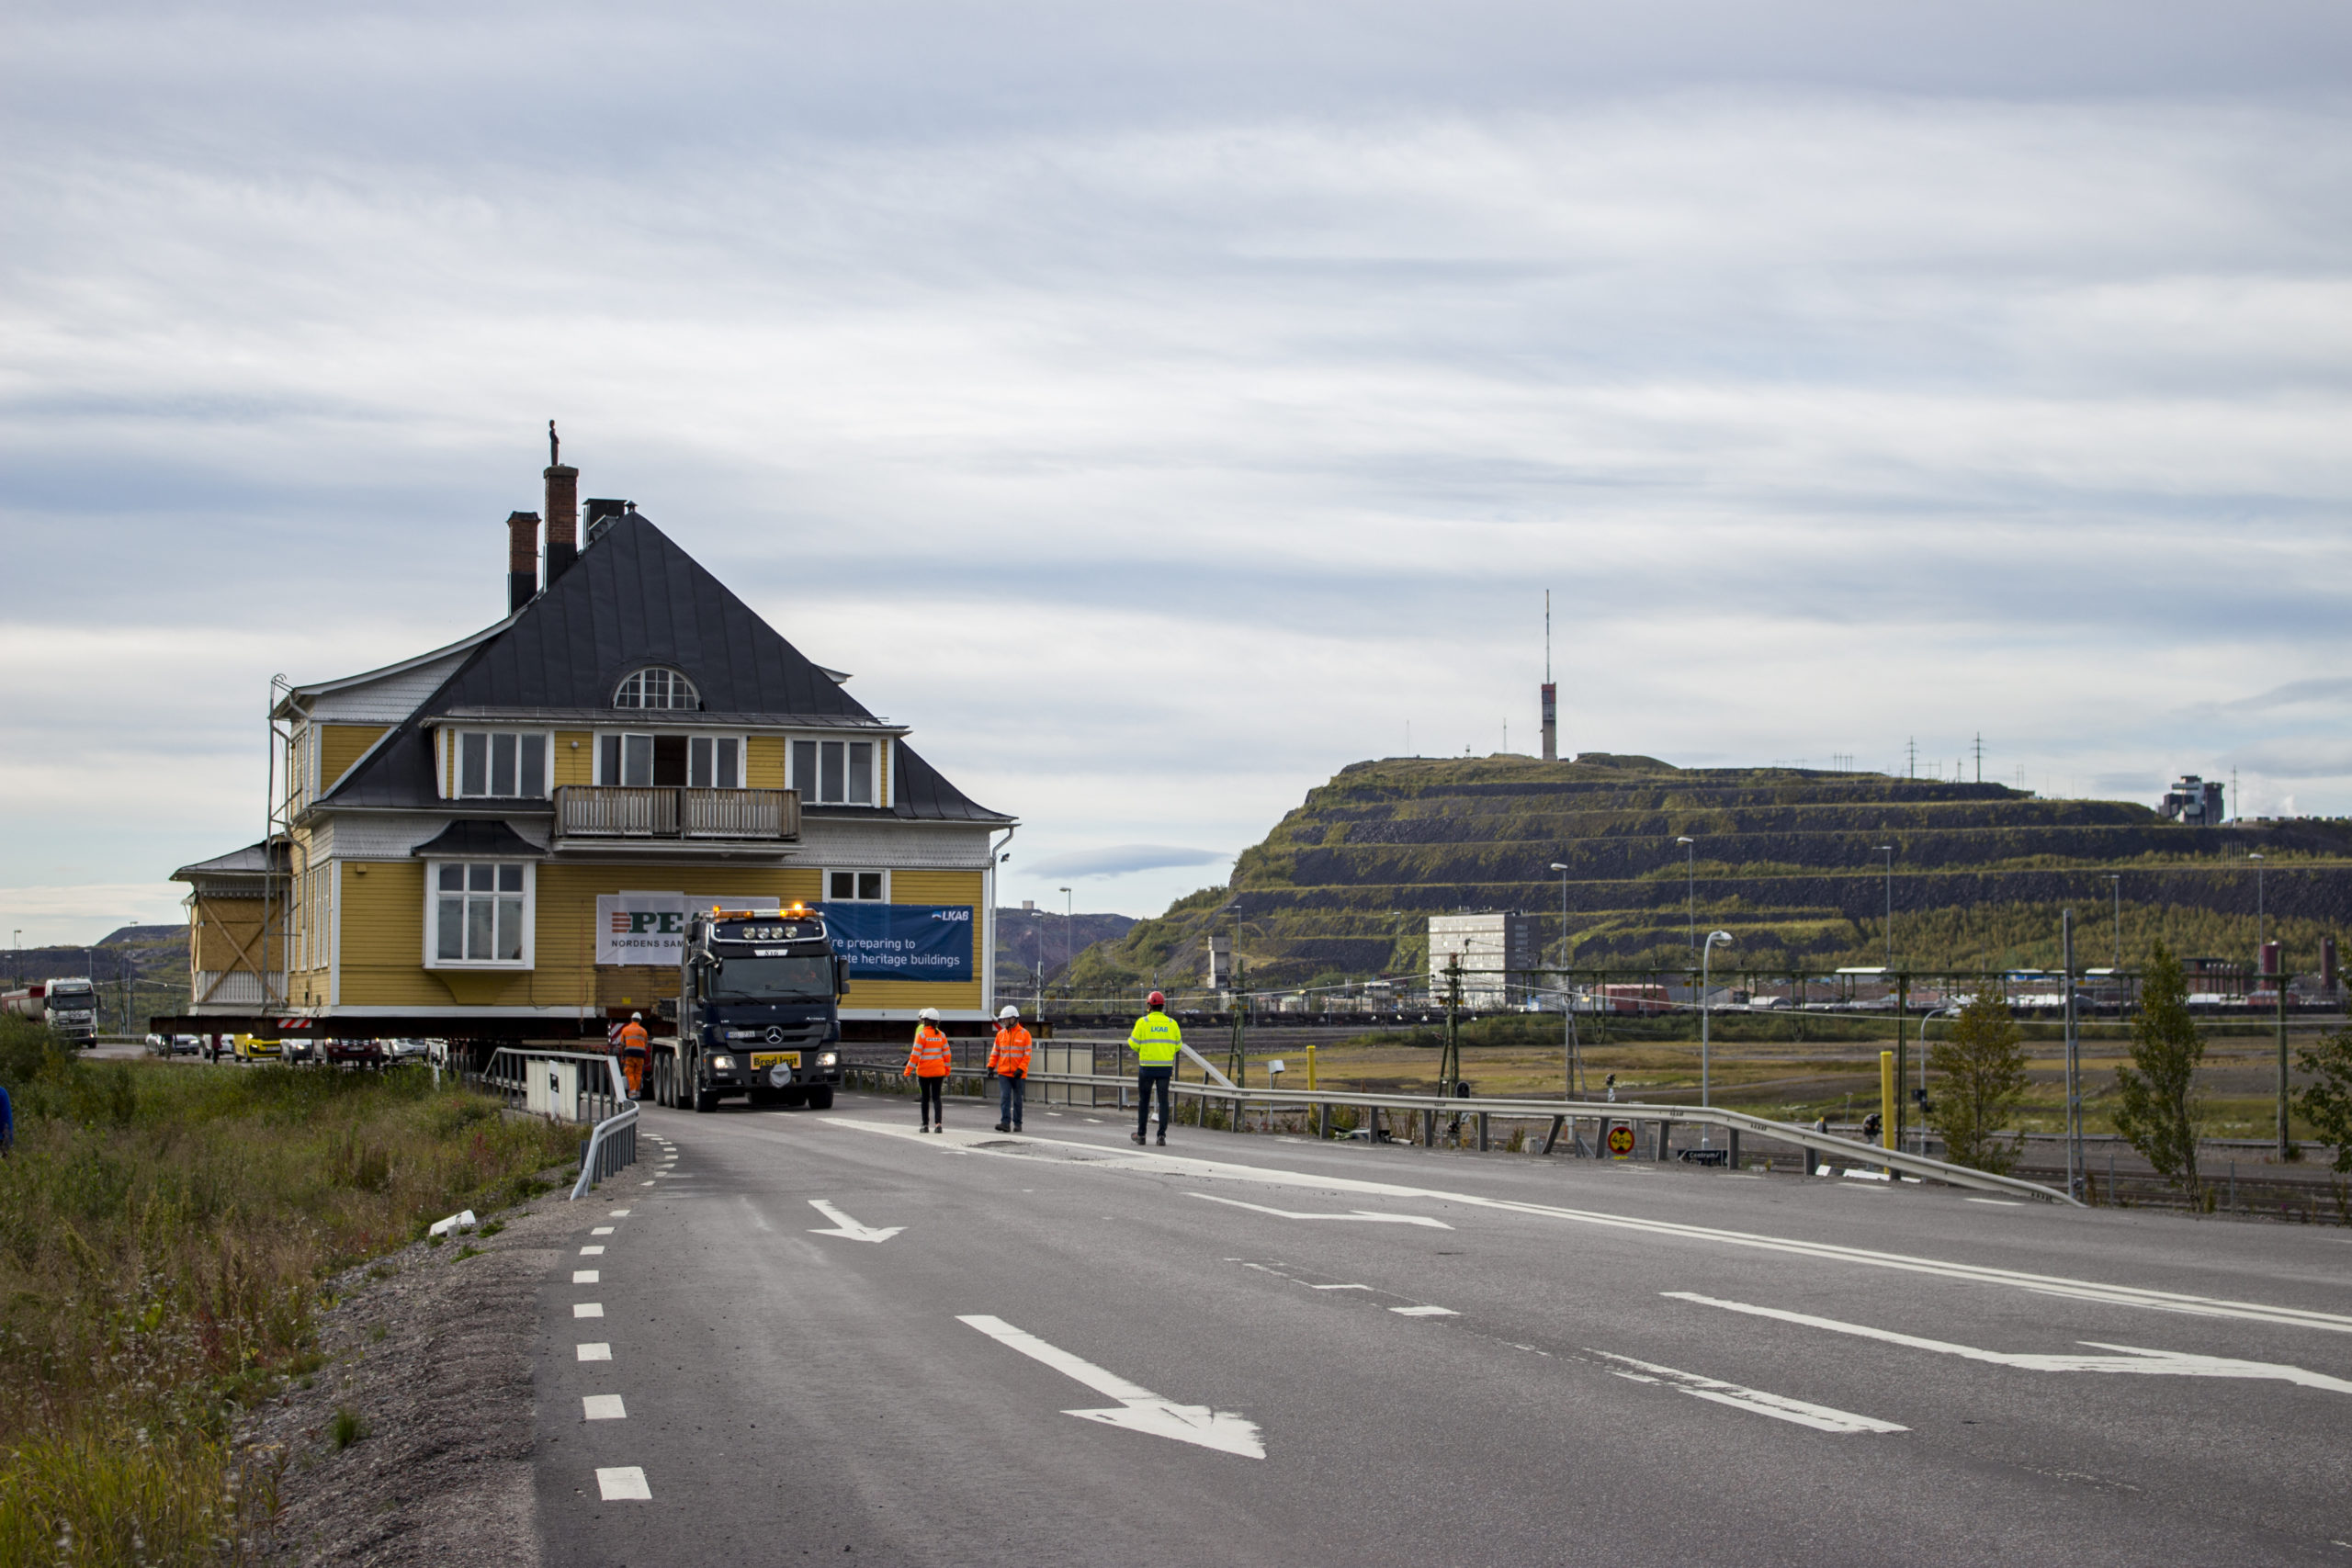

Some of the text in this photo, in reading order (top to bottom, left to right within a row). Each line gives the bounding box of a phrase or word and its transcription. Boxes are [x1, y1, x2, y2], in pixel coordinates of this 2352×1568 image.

[942, 910, 969, 921] LKAB
[611, 940, 660, 948] NORDENS
[847, 938, 901, 951] preparing
[905, 939, 916, 949] to
[861, 953, 908, 966] heritage
[910, 953, 960, 967] buildings
[753, 1056, 777, 1066] Bred
